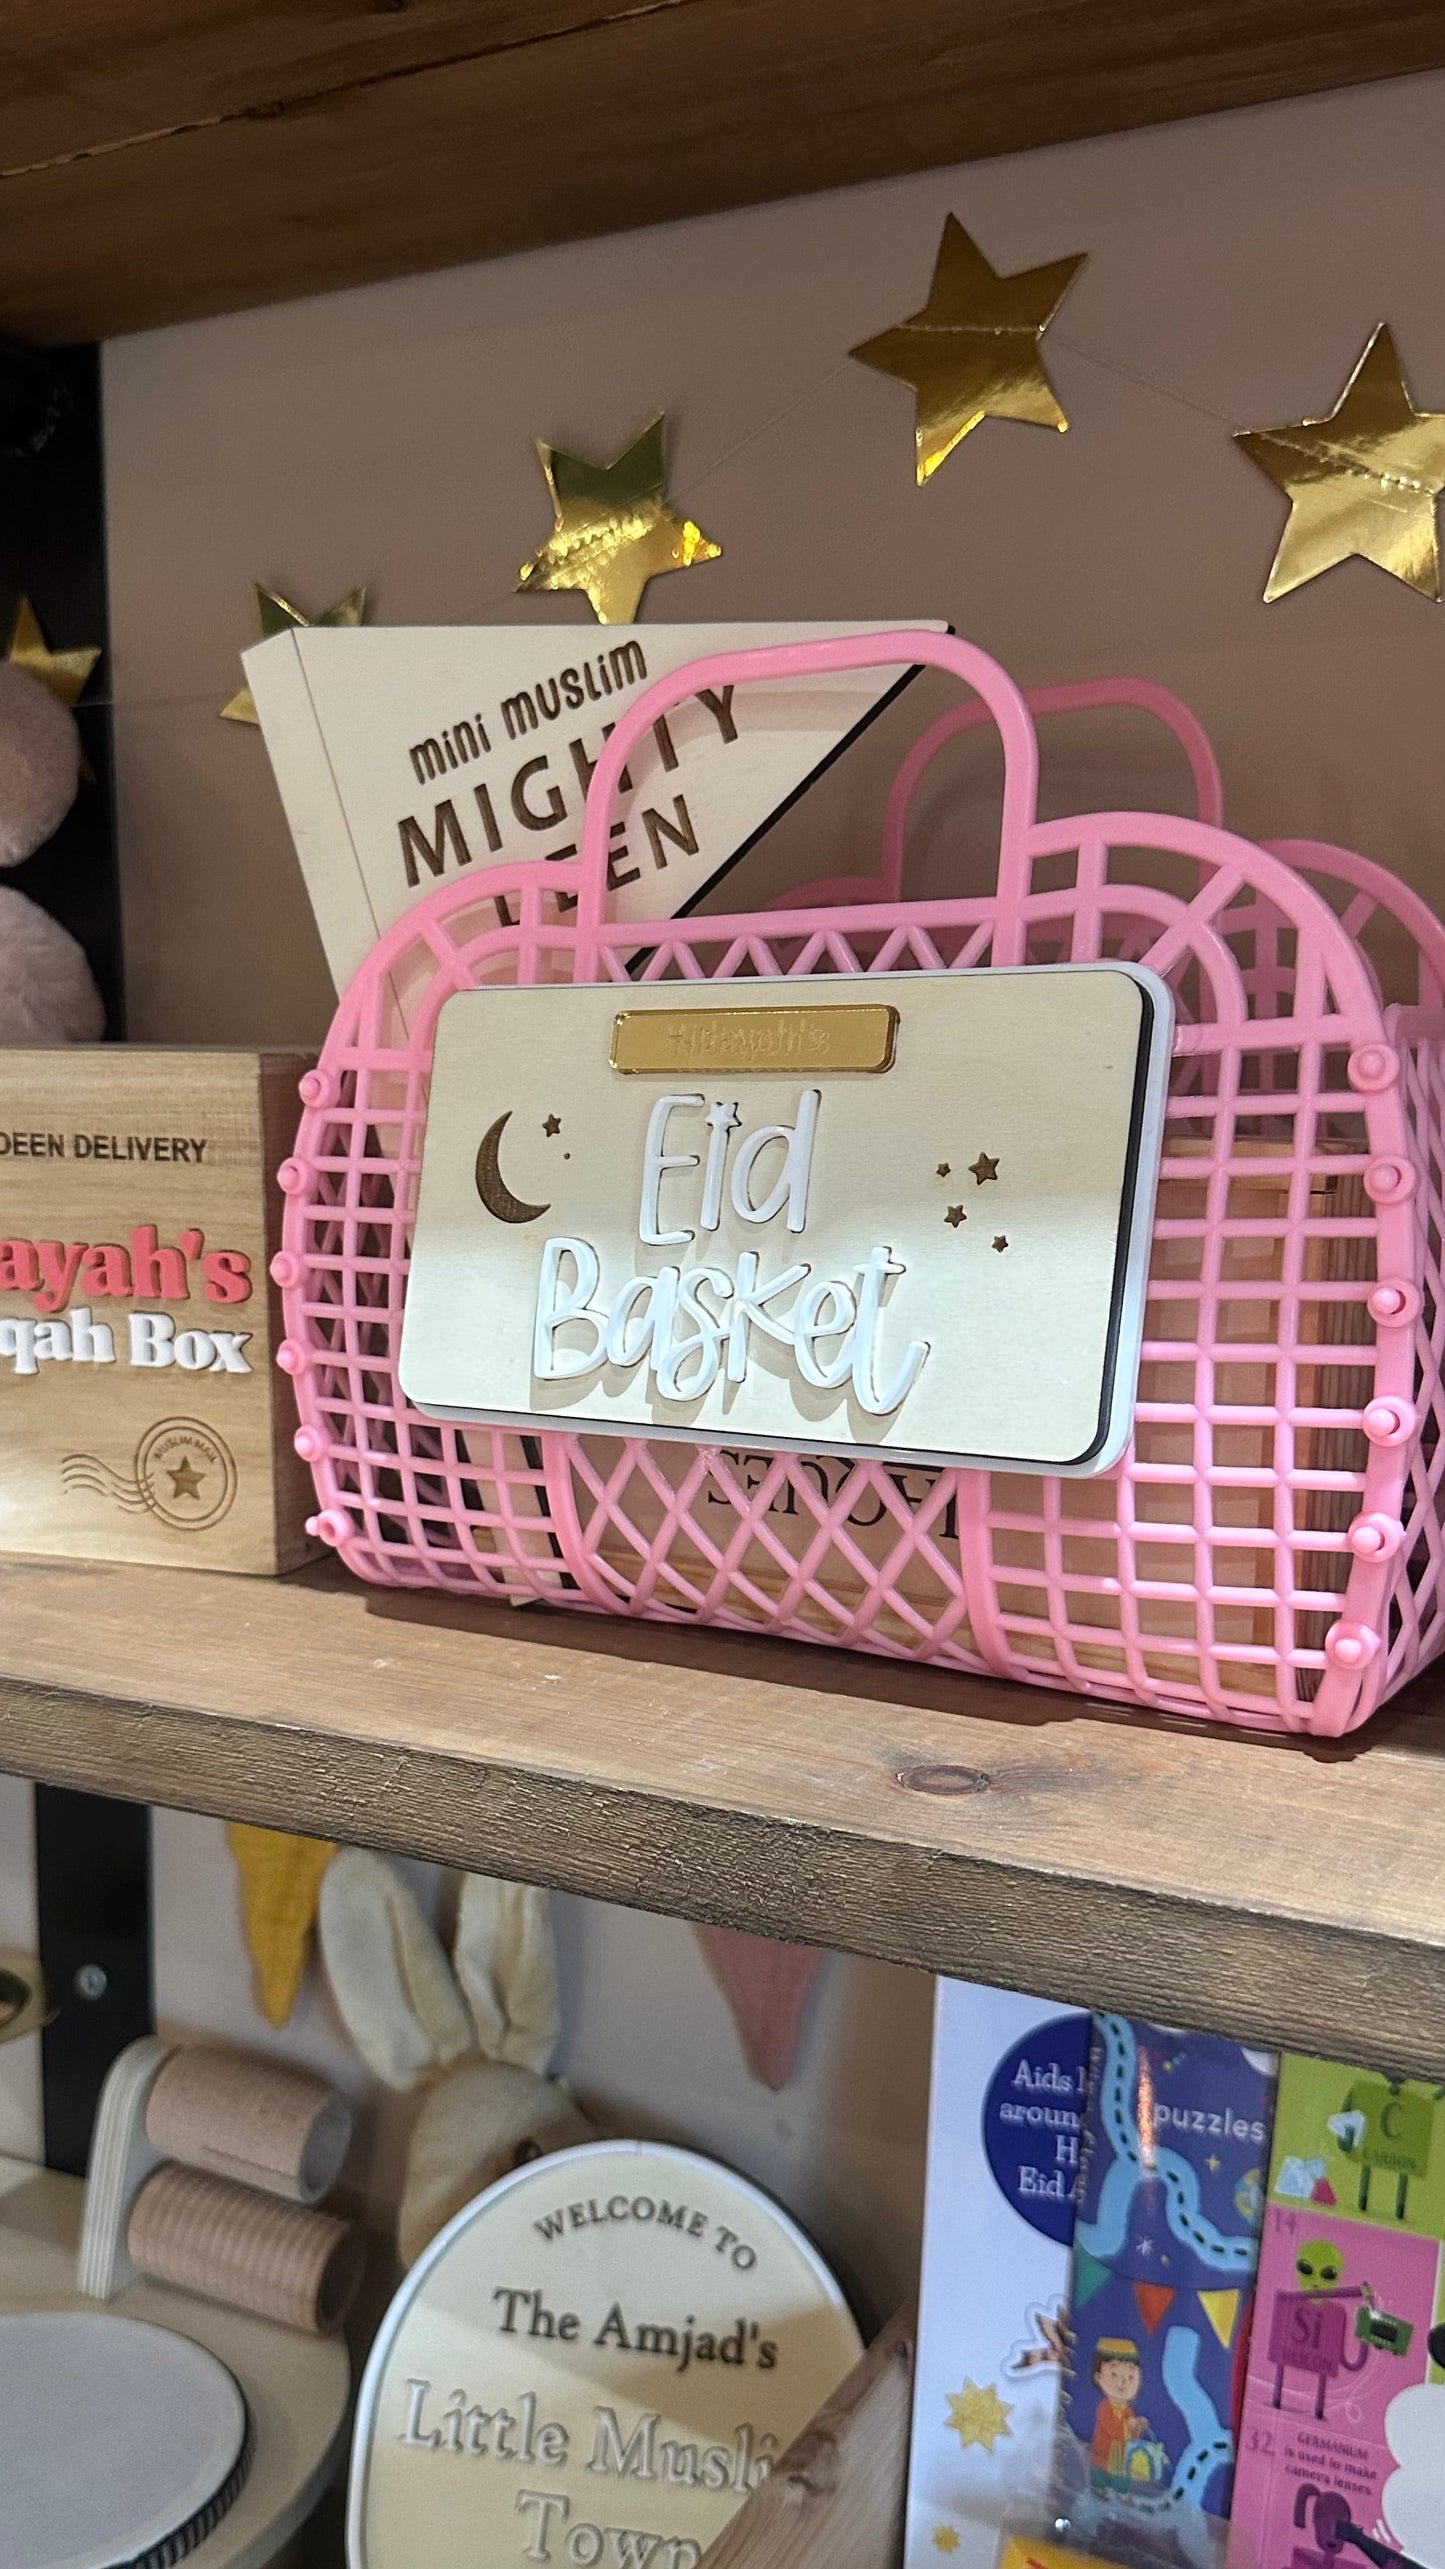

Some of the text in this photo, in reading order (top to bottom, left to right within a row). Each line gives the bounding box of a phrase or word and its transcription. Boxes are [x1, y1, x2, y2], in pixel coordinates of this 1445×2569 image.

[408, 711, 492, 786] mini
[74, 1133, 208, 1164] DELIVERY
[639, 1089, 822, 1246] Eid
[128, 1310, 253, 1374] Box
[533, 1236, 931, 1415] Basket
[1010, 2059, 1074, 2092] Aids
[1000, 2102, 1080, 2128] aroun
[1153, 2102, 1265, 2142] puzzles
[1018, 2165, 1066, 2198] Eid
[534, 2196, 757, 2272] WELCOME TO
[493, 2286, 779, 2373] The Amjad's
[399, 2377, 779, 2496] Little Musli
